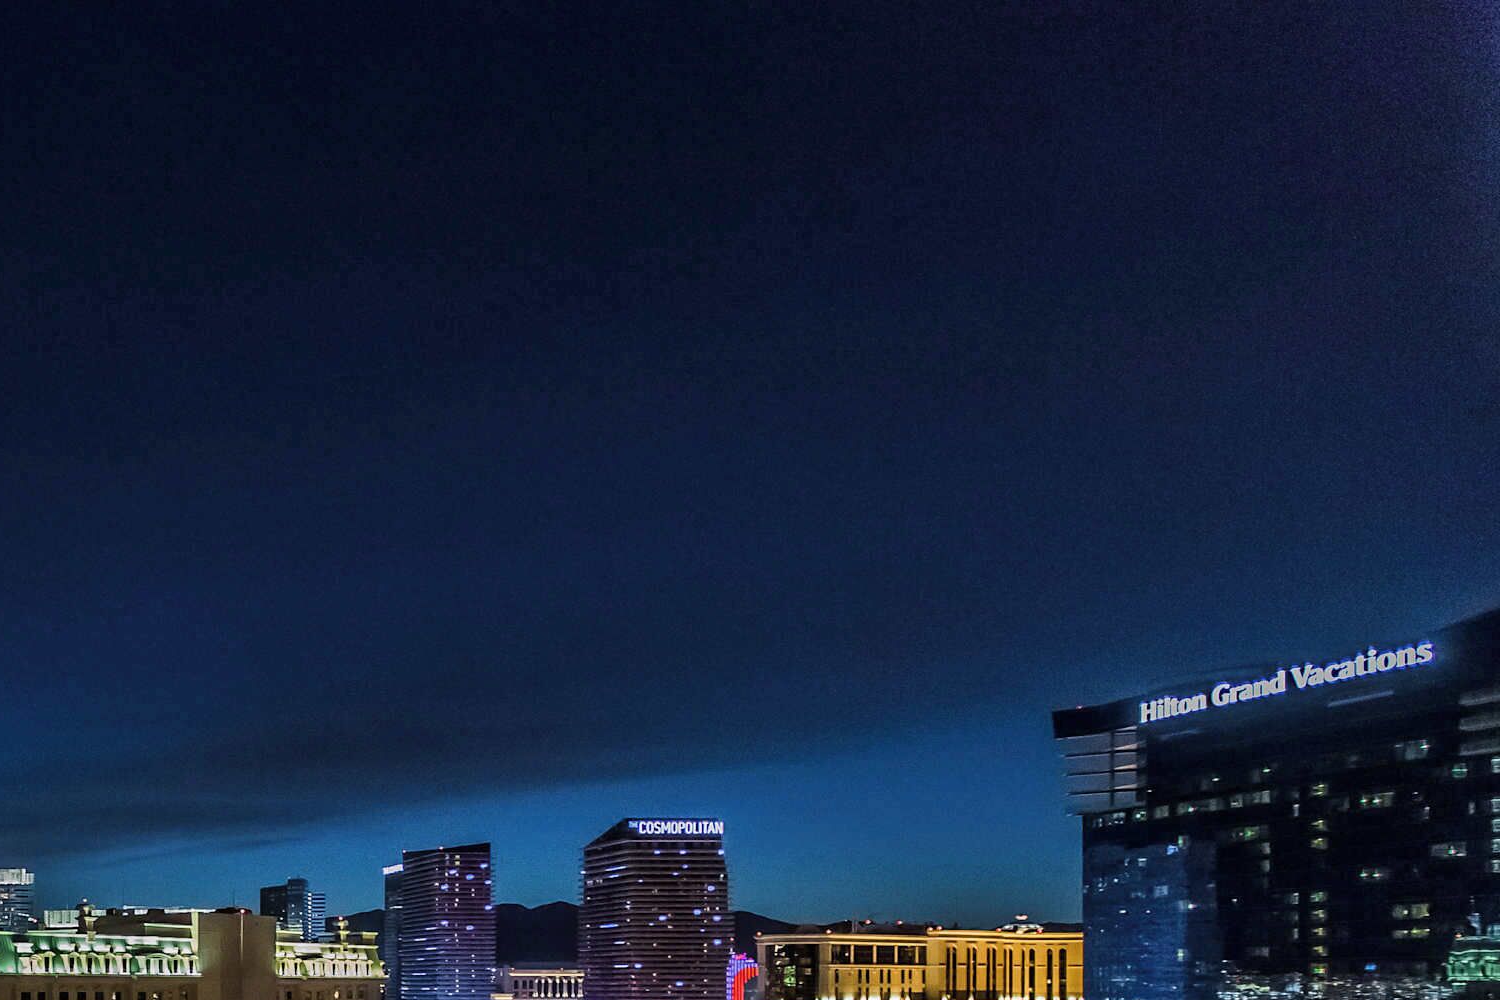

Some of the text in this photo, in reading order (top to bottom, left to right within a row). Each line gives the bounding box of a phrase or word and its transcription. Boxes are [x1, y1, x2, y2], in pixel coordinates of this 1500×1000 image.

[1140, 642, 1434, 724] Hilton Grand Vacations
[638, 821, 724, 834] COSMOPOLITAN
